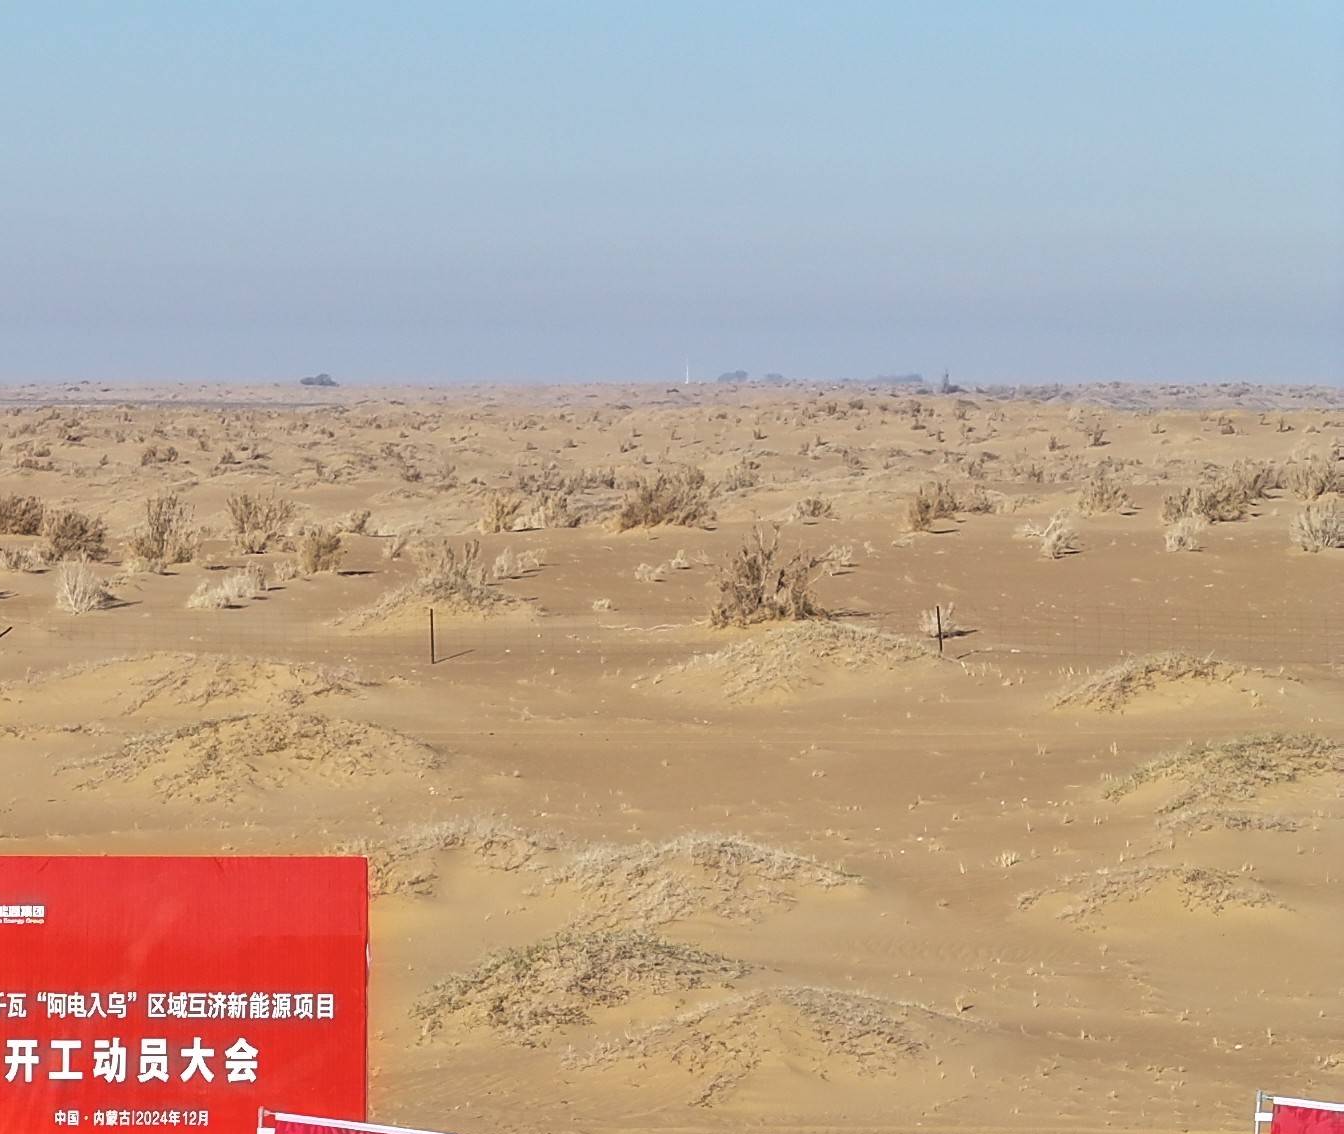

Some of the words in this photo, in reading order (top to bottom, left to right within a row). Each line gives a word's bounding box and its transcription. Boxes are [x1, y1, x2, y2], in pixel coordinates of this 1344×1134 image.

[4, 1036, 259, 1083] 开工动员大会
